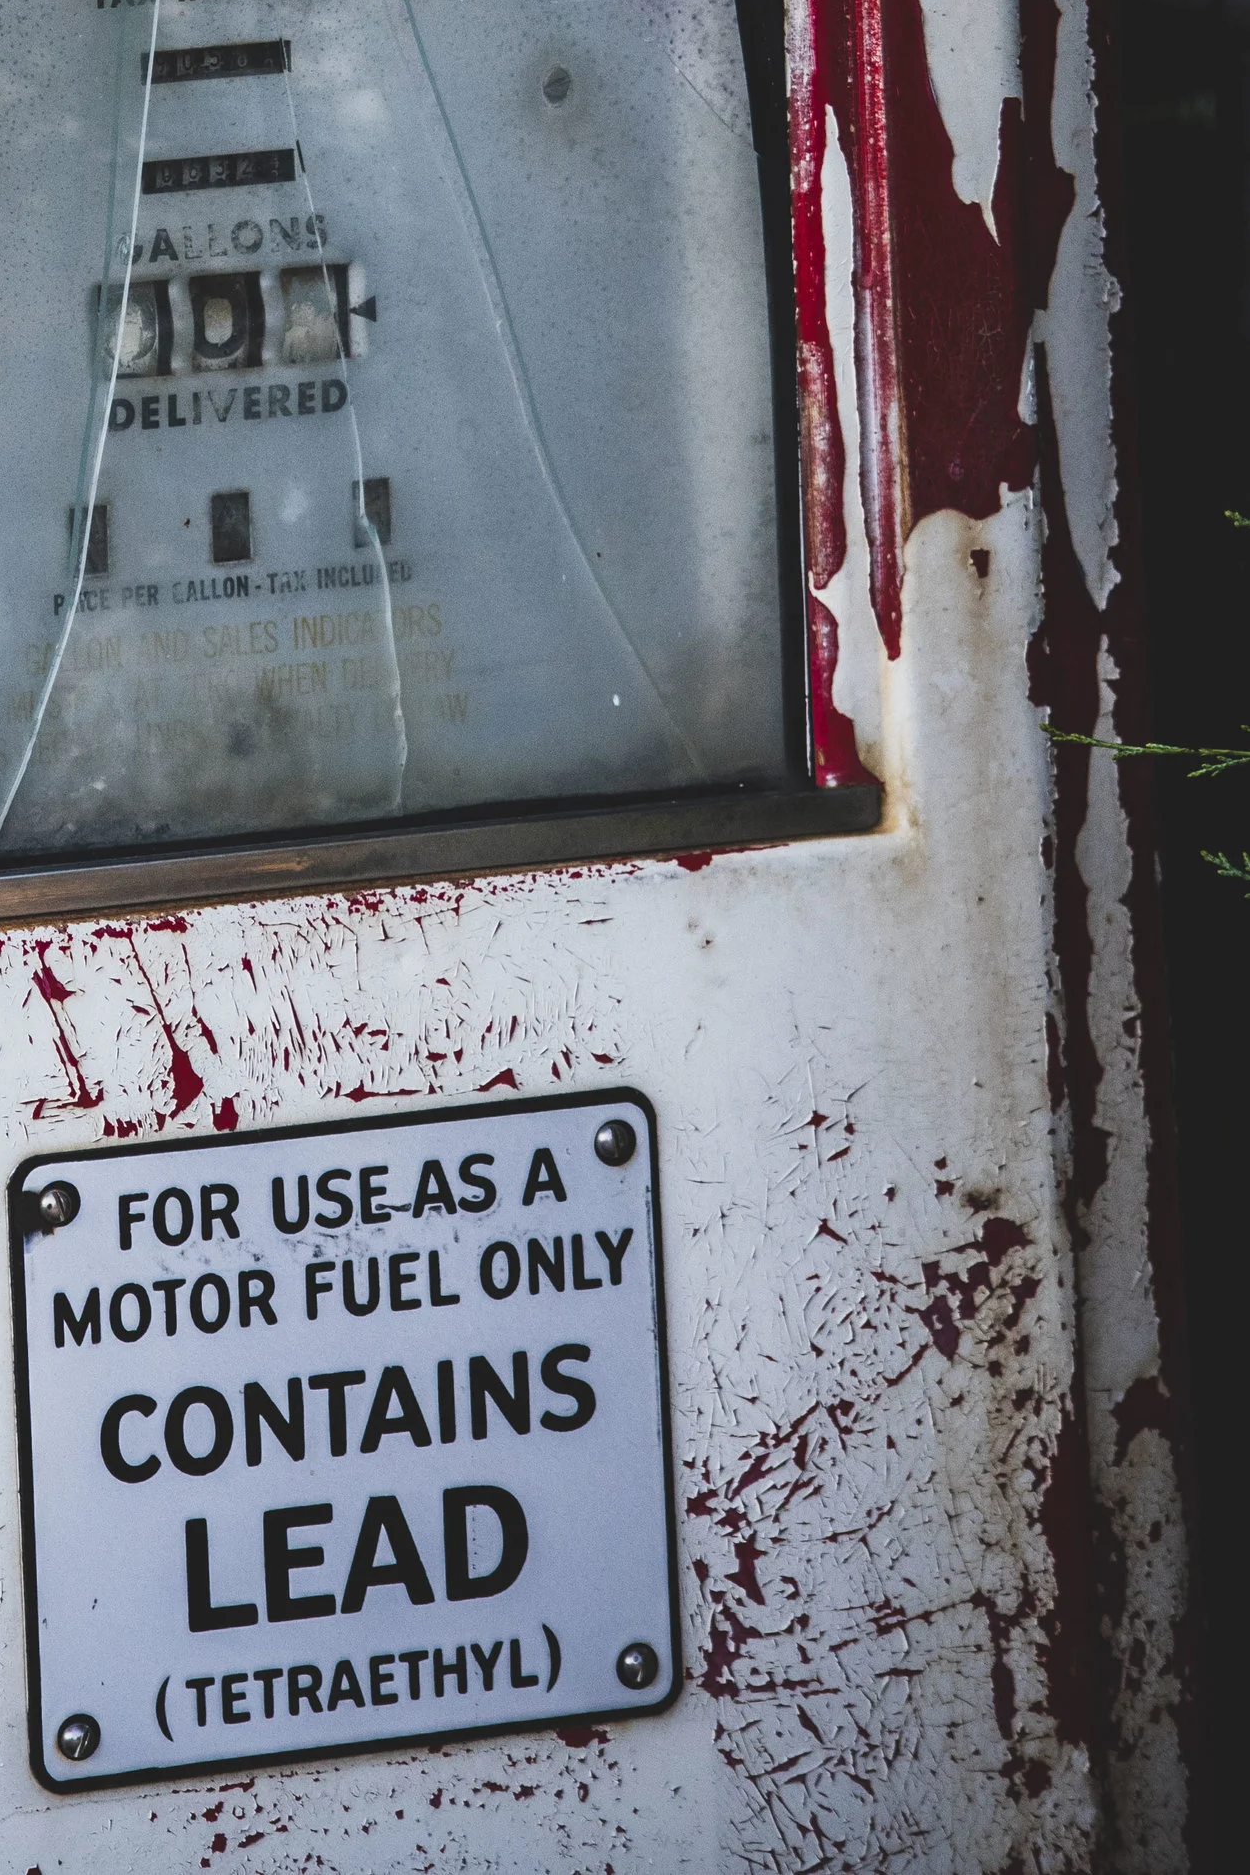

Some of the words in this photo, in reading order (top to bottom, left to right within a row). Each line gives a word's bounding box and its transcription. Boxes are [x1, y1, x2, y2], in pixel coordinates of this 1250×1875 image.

[108, 378, 349, 432] DELIVERED
[121, 584, 158, 609] PER
[202, 619, 279, 660] SALES
[293, 602, 443, 652] INDICAORS
[118, 1182, 241, 1251] FOR
[271, 1164, 391, 1236] USE
[411, 1153, 497, 1216] AS
[521, 1147, 567, 1207] A
[52, 1269, 278, 1349] MOTOR
[304, 1250, 461, 1320] FUEL
[479, 1227, 633, 1301] ONLY
[100, 1342, 597, 1484] CONTAINS
[185, 1484, 530, 1634] LEAD
[155, 1623, 562, 1742] (TETRAETHYL)
